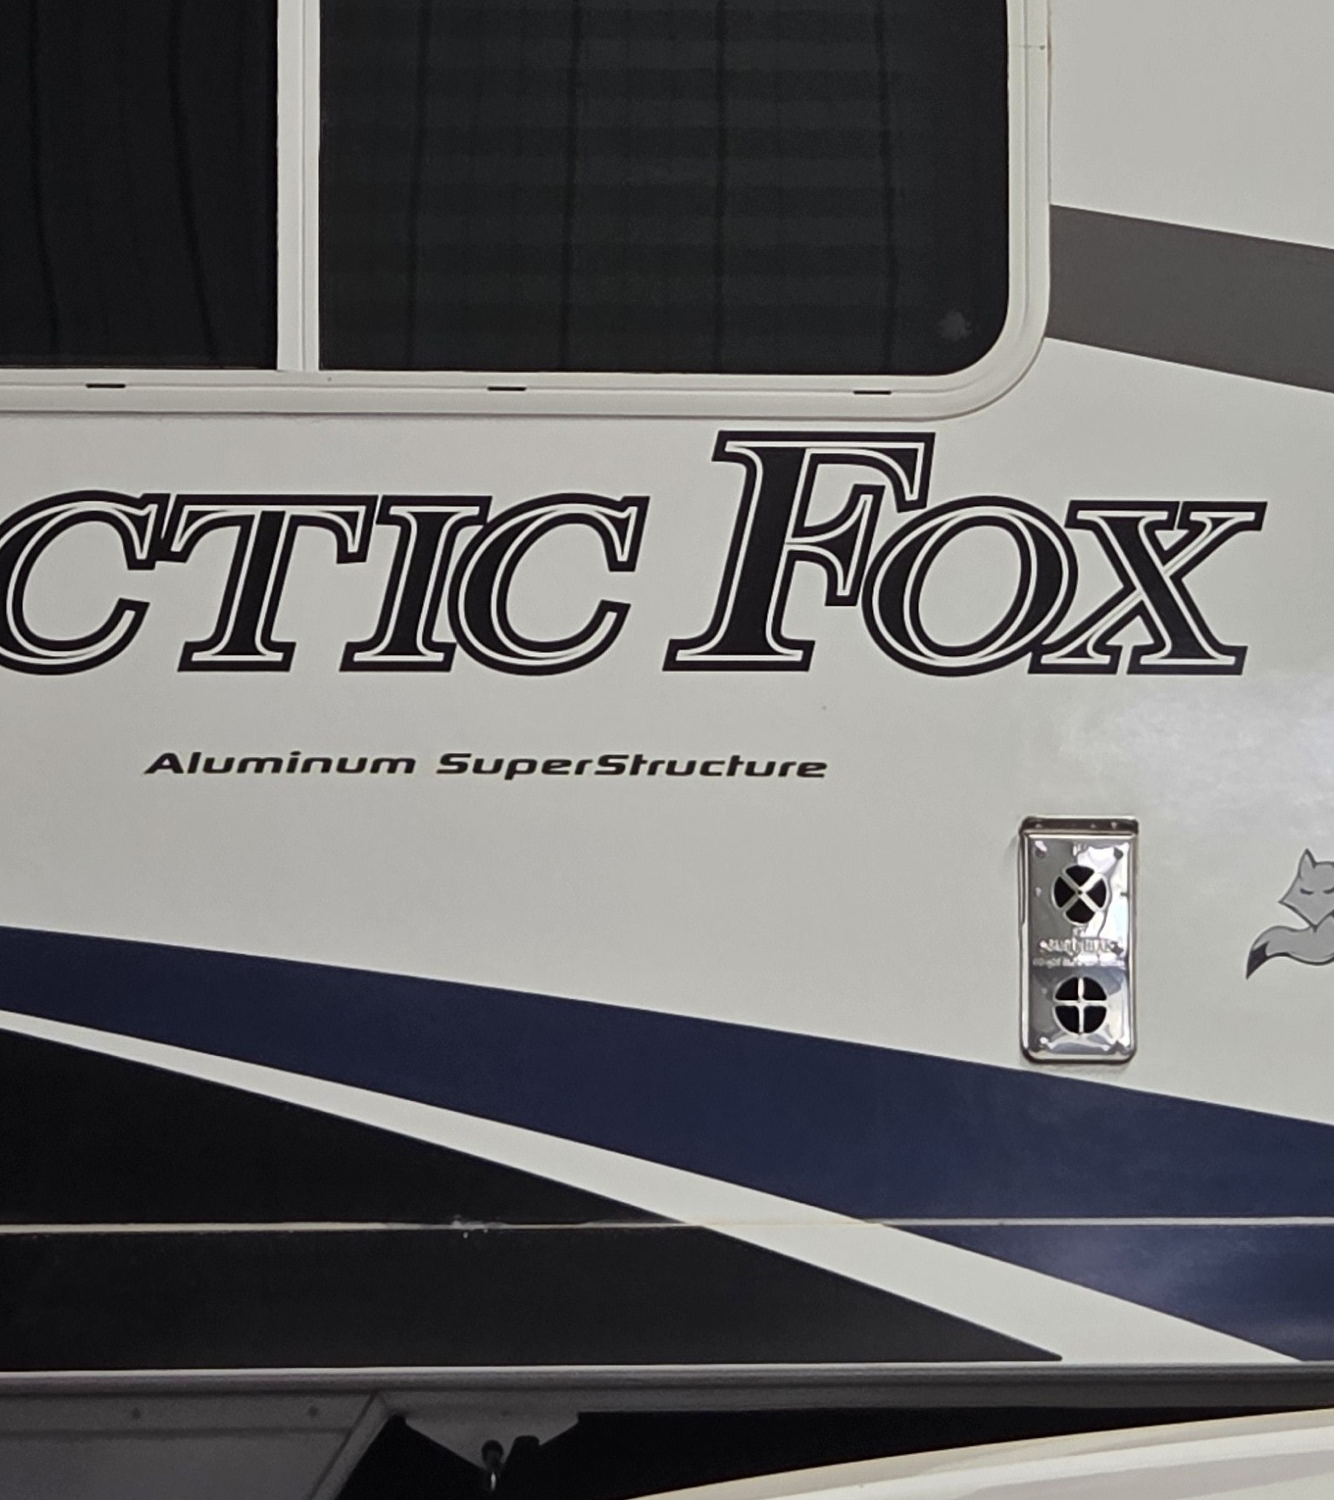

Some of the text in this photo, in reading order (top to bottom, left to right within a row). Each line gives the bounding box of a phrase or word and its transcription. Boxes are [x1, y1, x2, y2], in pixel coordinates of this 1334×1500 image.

[662, 429, 1267, 678] FOX
[143, 750, 829, 781] Aluminum SuperStructure
